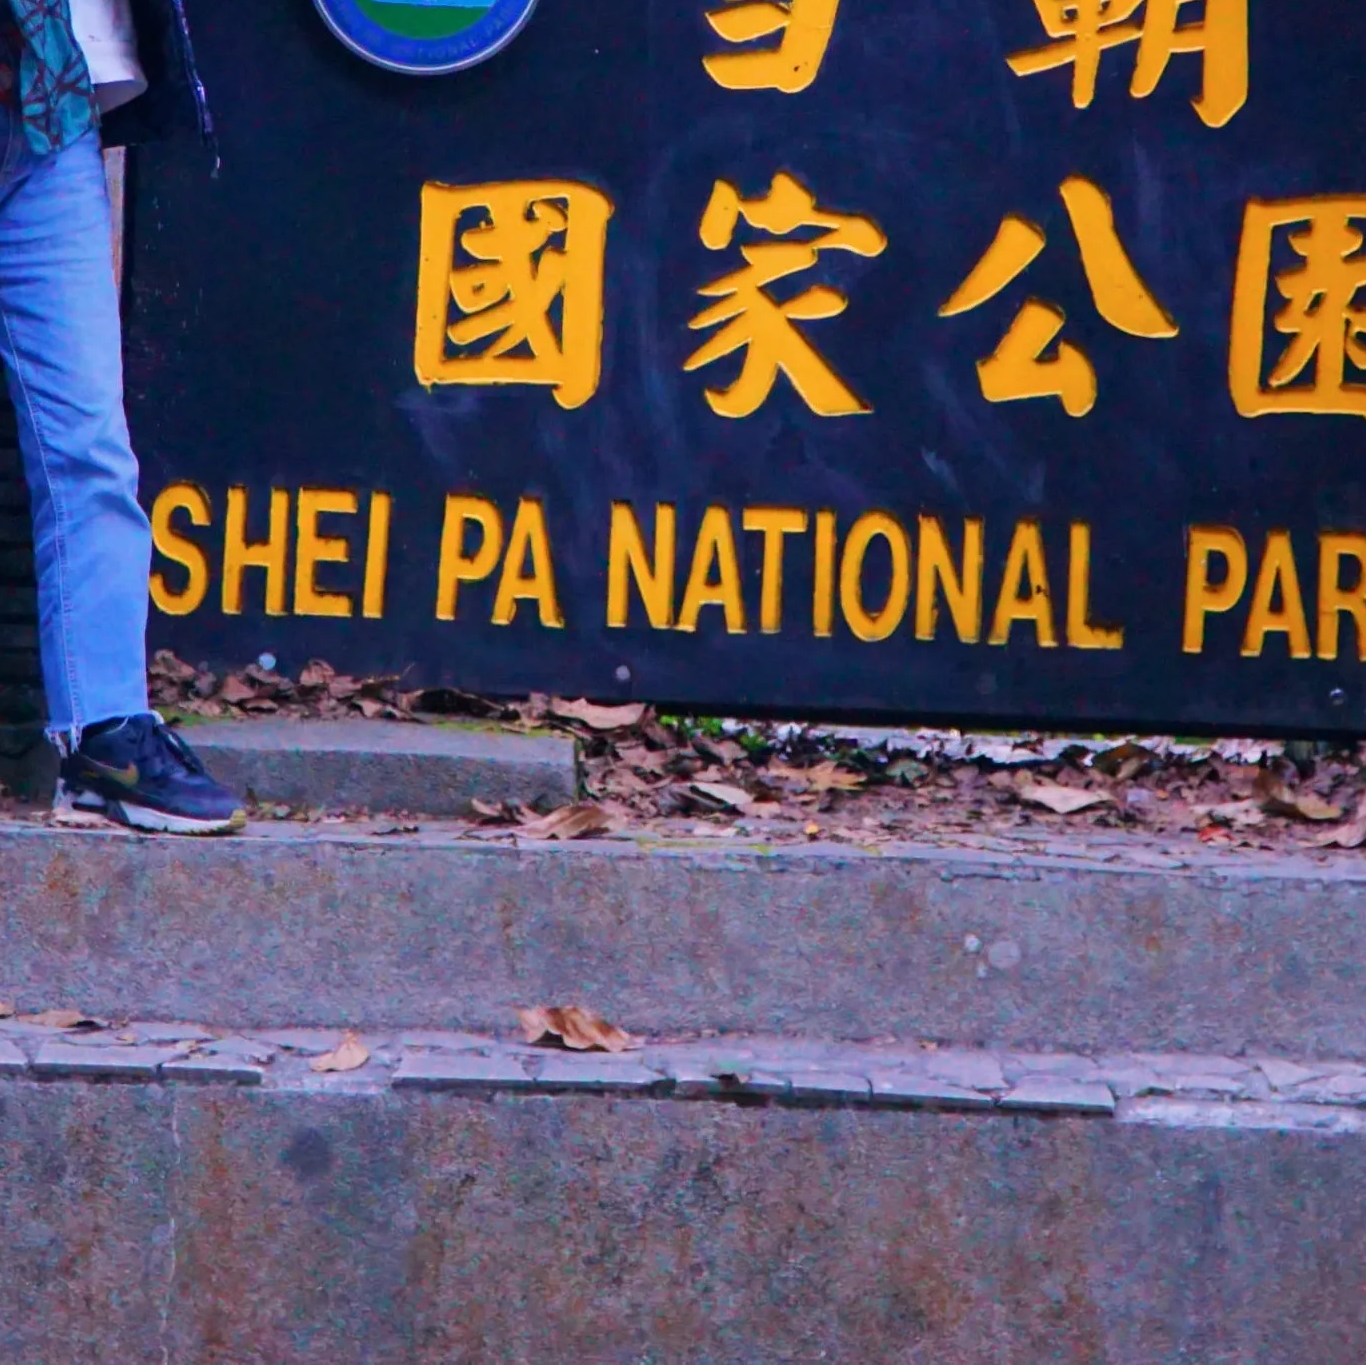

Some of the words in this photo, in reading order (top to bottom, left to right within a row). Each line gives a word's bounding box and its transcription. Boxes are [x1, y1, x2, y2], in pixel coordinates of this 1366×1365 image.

[148, 481, 392, 619] SHEI
[434, 493, 566, 629] PA
[606, 502, 1125, 650] NATIONAL
